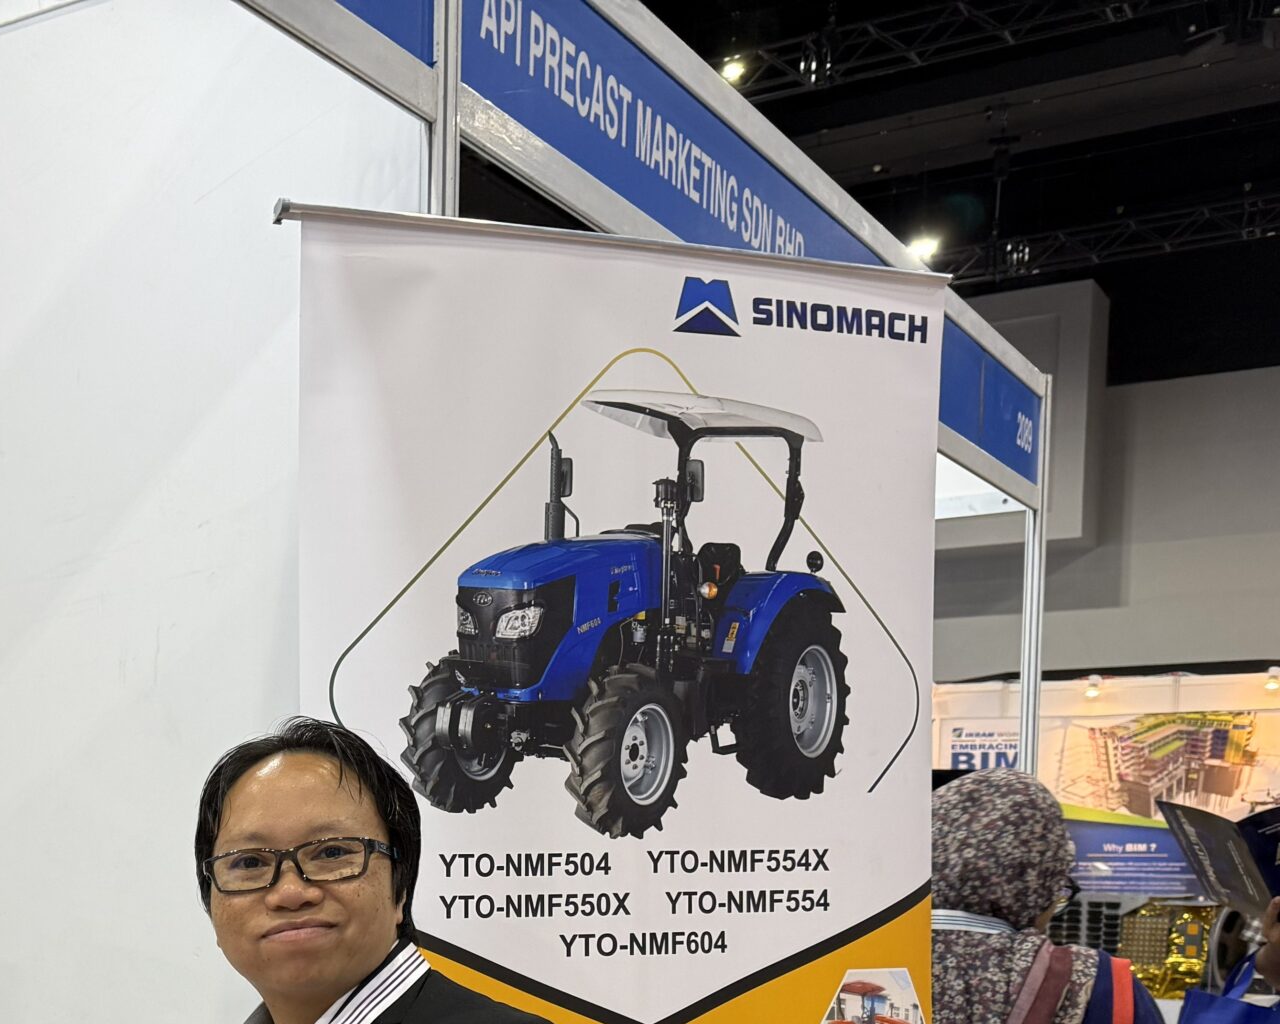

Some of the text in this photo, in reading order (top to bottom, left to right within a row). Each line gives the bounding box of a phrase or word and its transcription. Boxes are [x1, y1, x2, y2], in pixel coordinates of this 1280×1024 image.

[480, 0, 522, 66] API
[529, 10, 632, 147] PRECAST
[635, 99, 737, 232] MARKETING
[741, 188, 772, 253] SDN
[752, 297, 928, 343] SINOMACH
[439, 849, 829, 878] YTO-NMF504 YTO-NMF554X
[439, 889, 830, 918] YTO-NMF550X YTO-NMF554
[559, 931, 727, 957] YTO-NMF604
